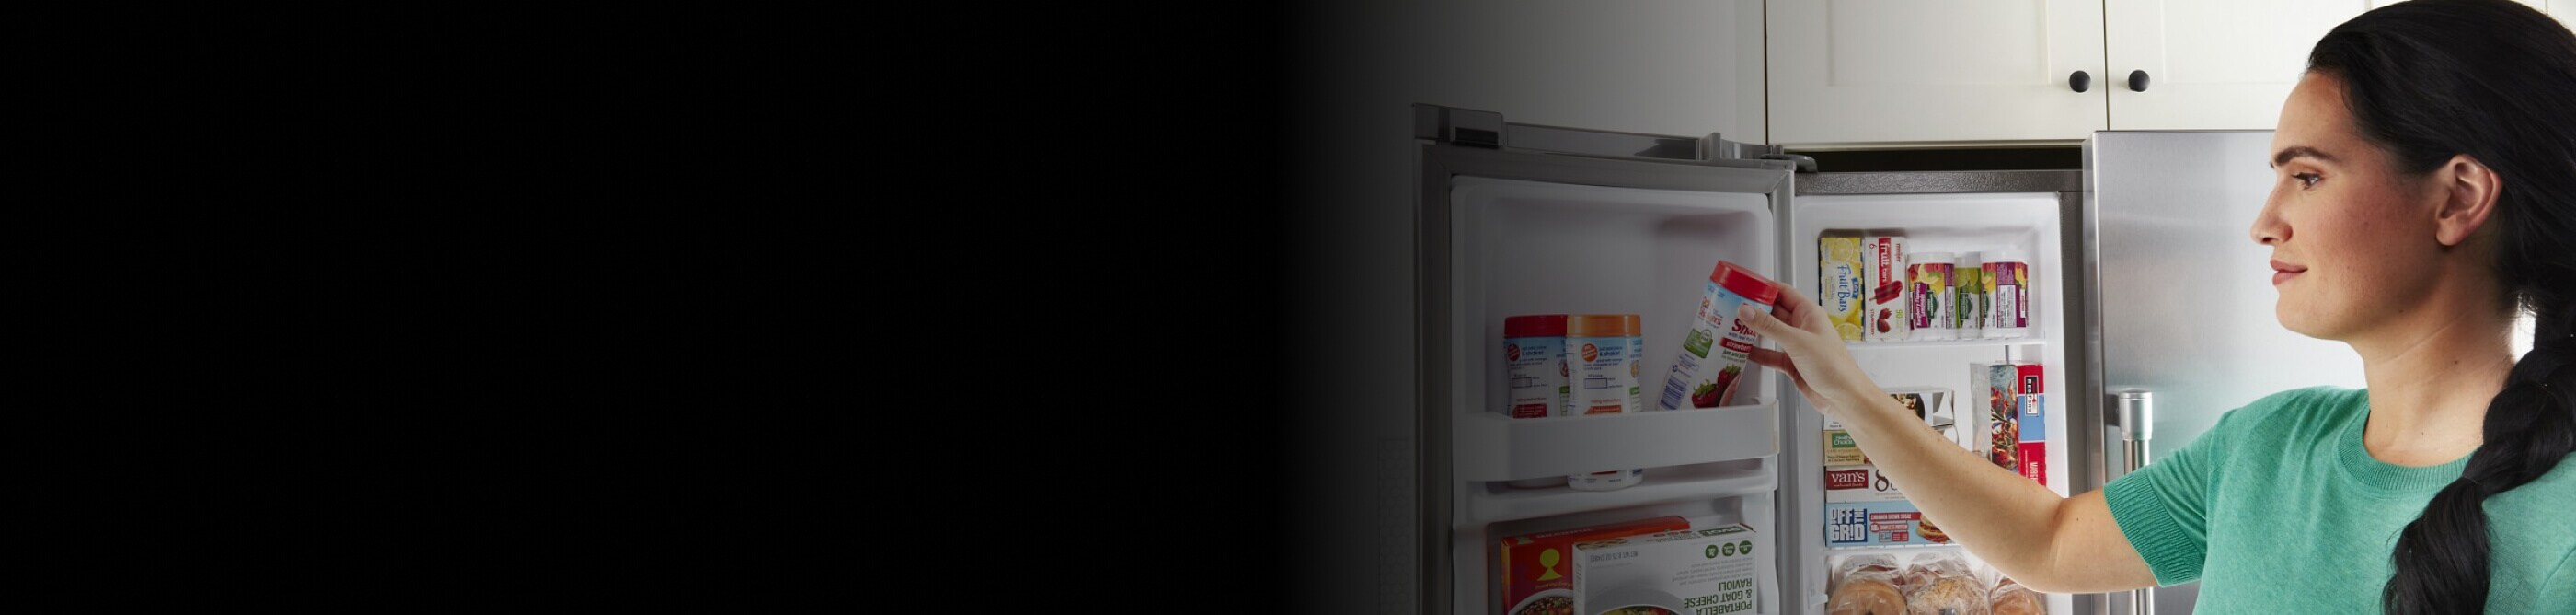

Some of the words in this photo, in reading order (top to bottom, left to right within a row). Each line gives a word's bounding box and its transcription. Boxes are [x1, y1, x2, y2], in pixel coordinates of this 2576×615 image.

[1880, 242, 1890, 267] fruit
[1837, 264, 1852, 288] Fruit
[1838, 291, 1851, 312] Bars
[1726, 341, 1752, 353] strawberr
[1831, 471, 1866, 483] van's
[1719, 577, 1753, 591] RAVIOLI
[1721, 590, 1743, 602] GOAT
[1745, 588, 1753, 598] &
[1684, 594, 1719, 609] CHEESE
[1696, 600, 1753, 615] PORTABELLA
